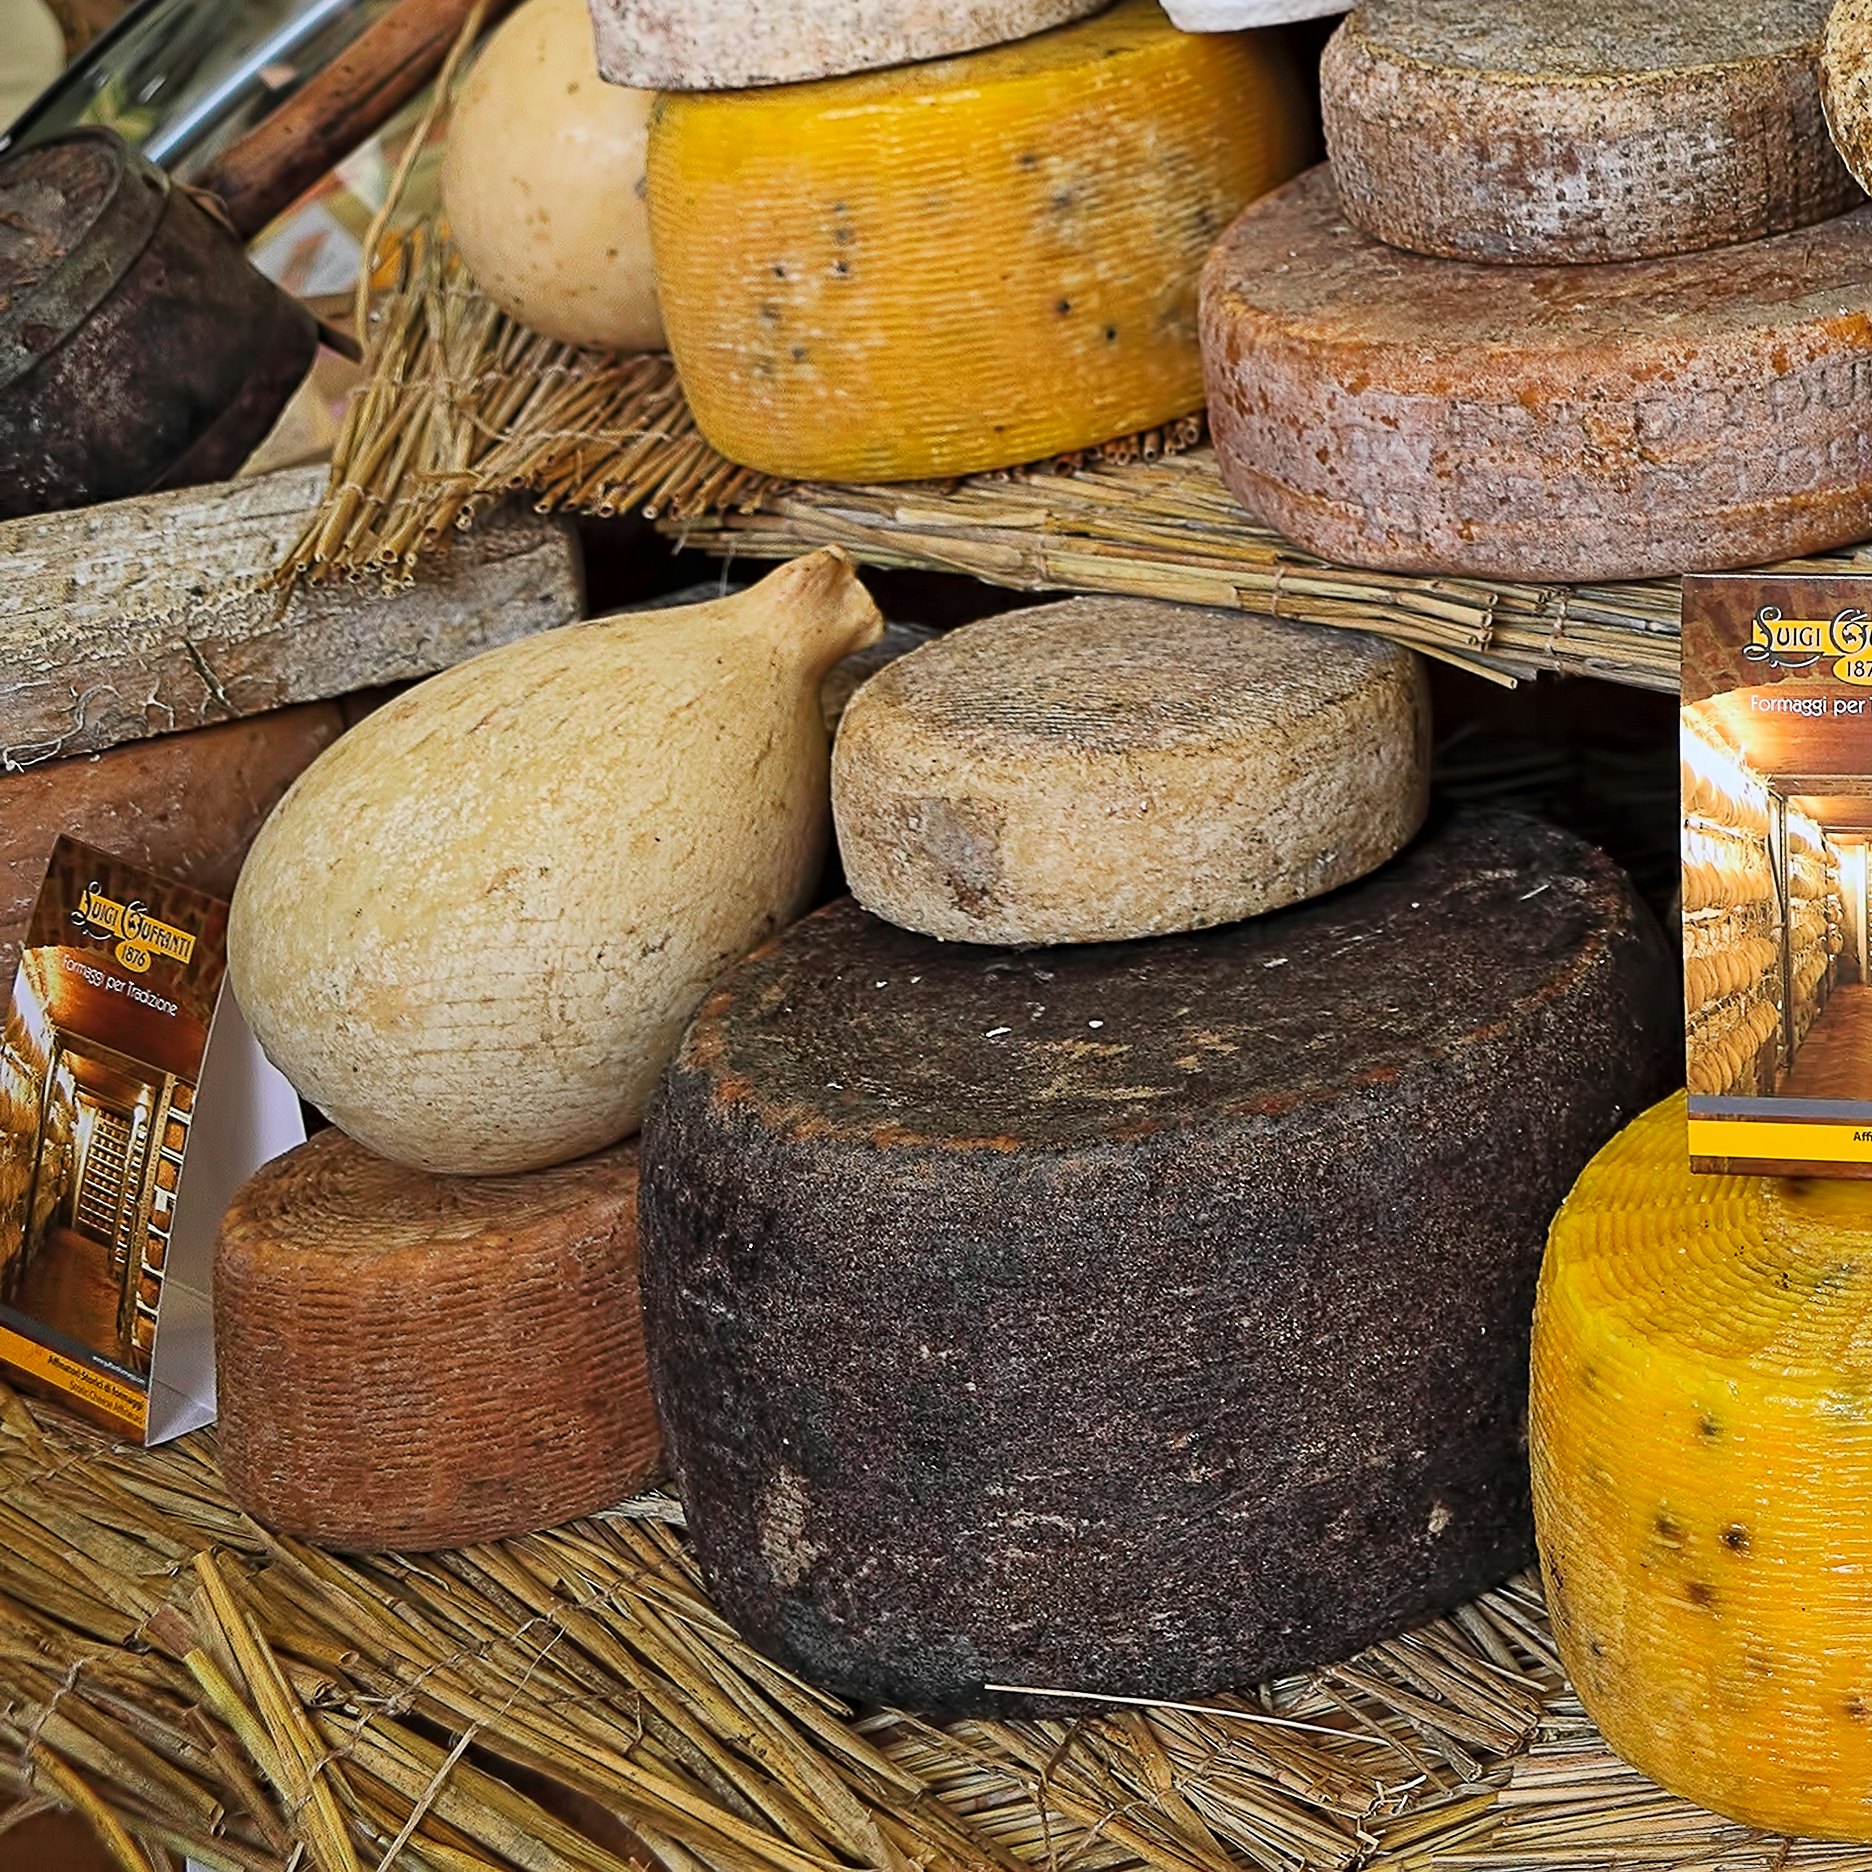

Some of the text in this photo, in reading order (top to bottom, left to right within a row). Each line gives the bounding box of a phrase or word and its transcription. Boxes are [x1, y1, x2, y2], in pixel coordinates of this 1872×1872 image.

[1750, 695, 1828, 717] Formaggi
[1833, 699, 1866, 717] per
[122, 945, 146, 967] 1876
